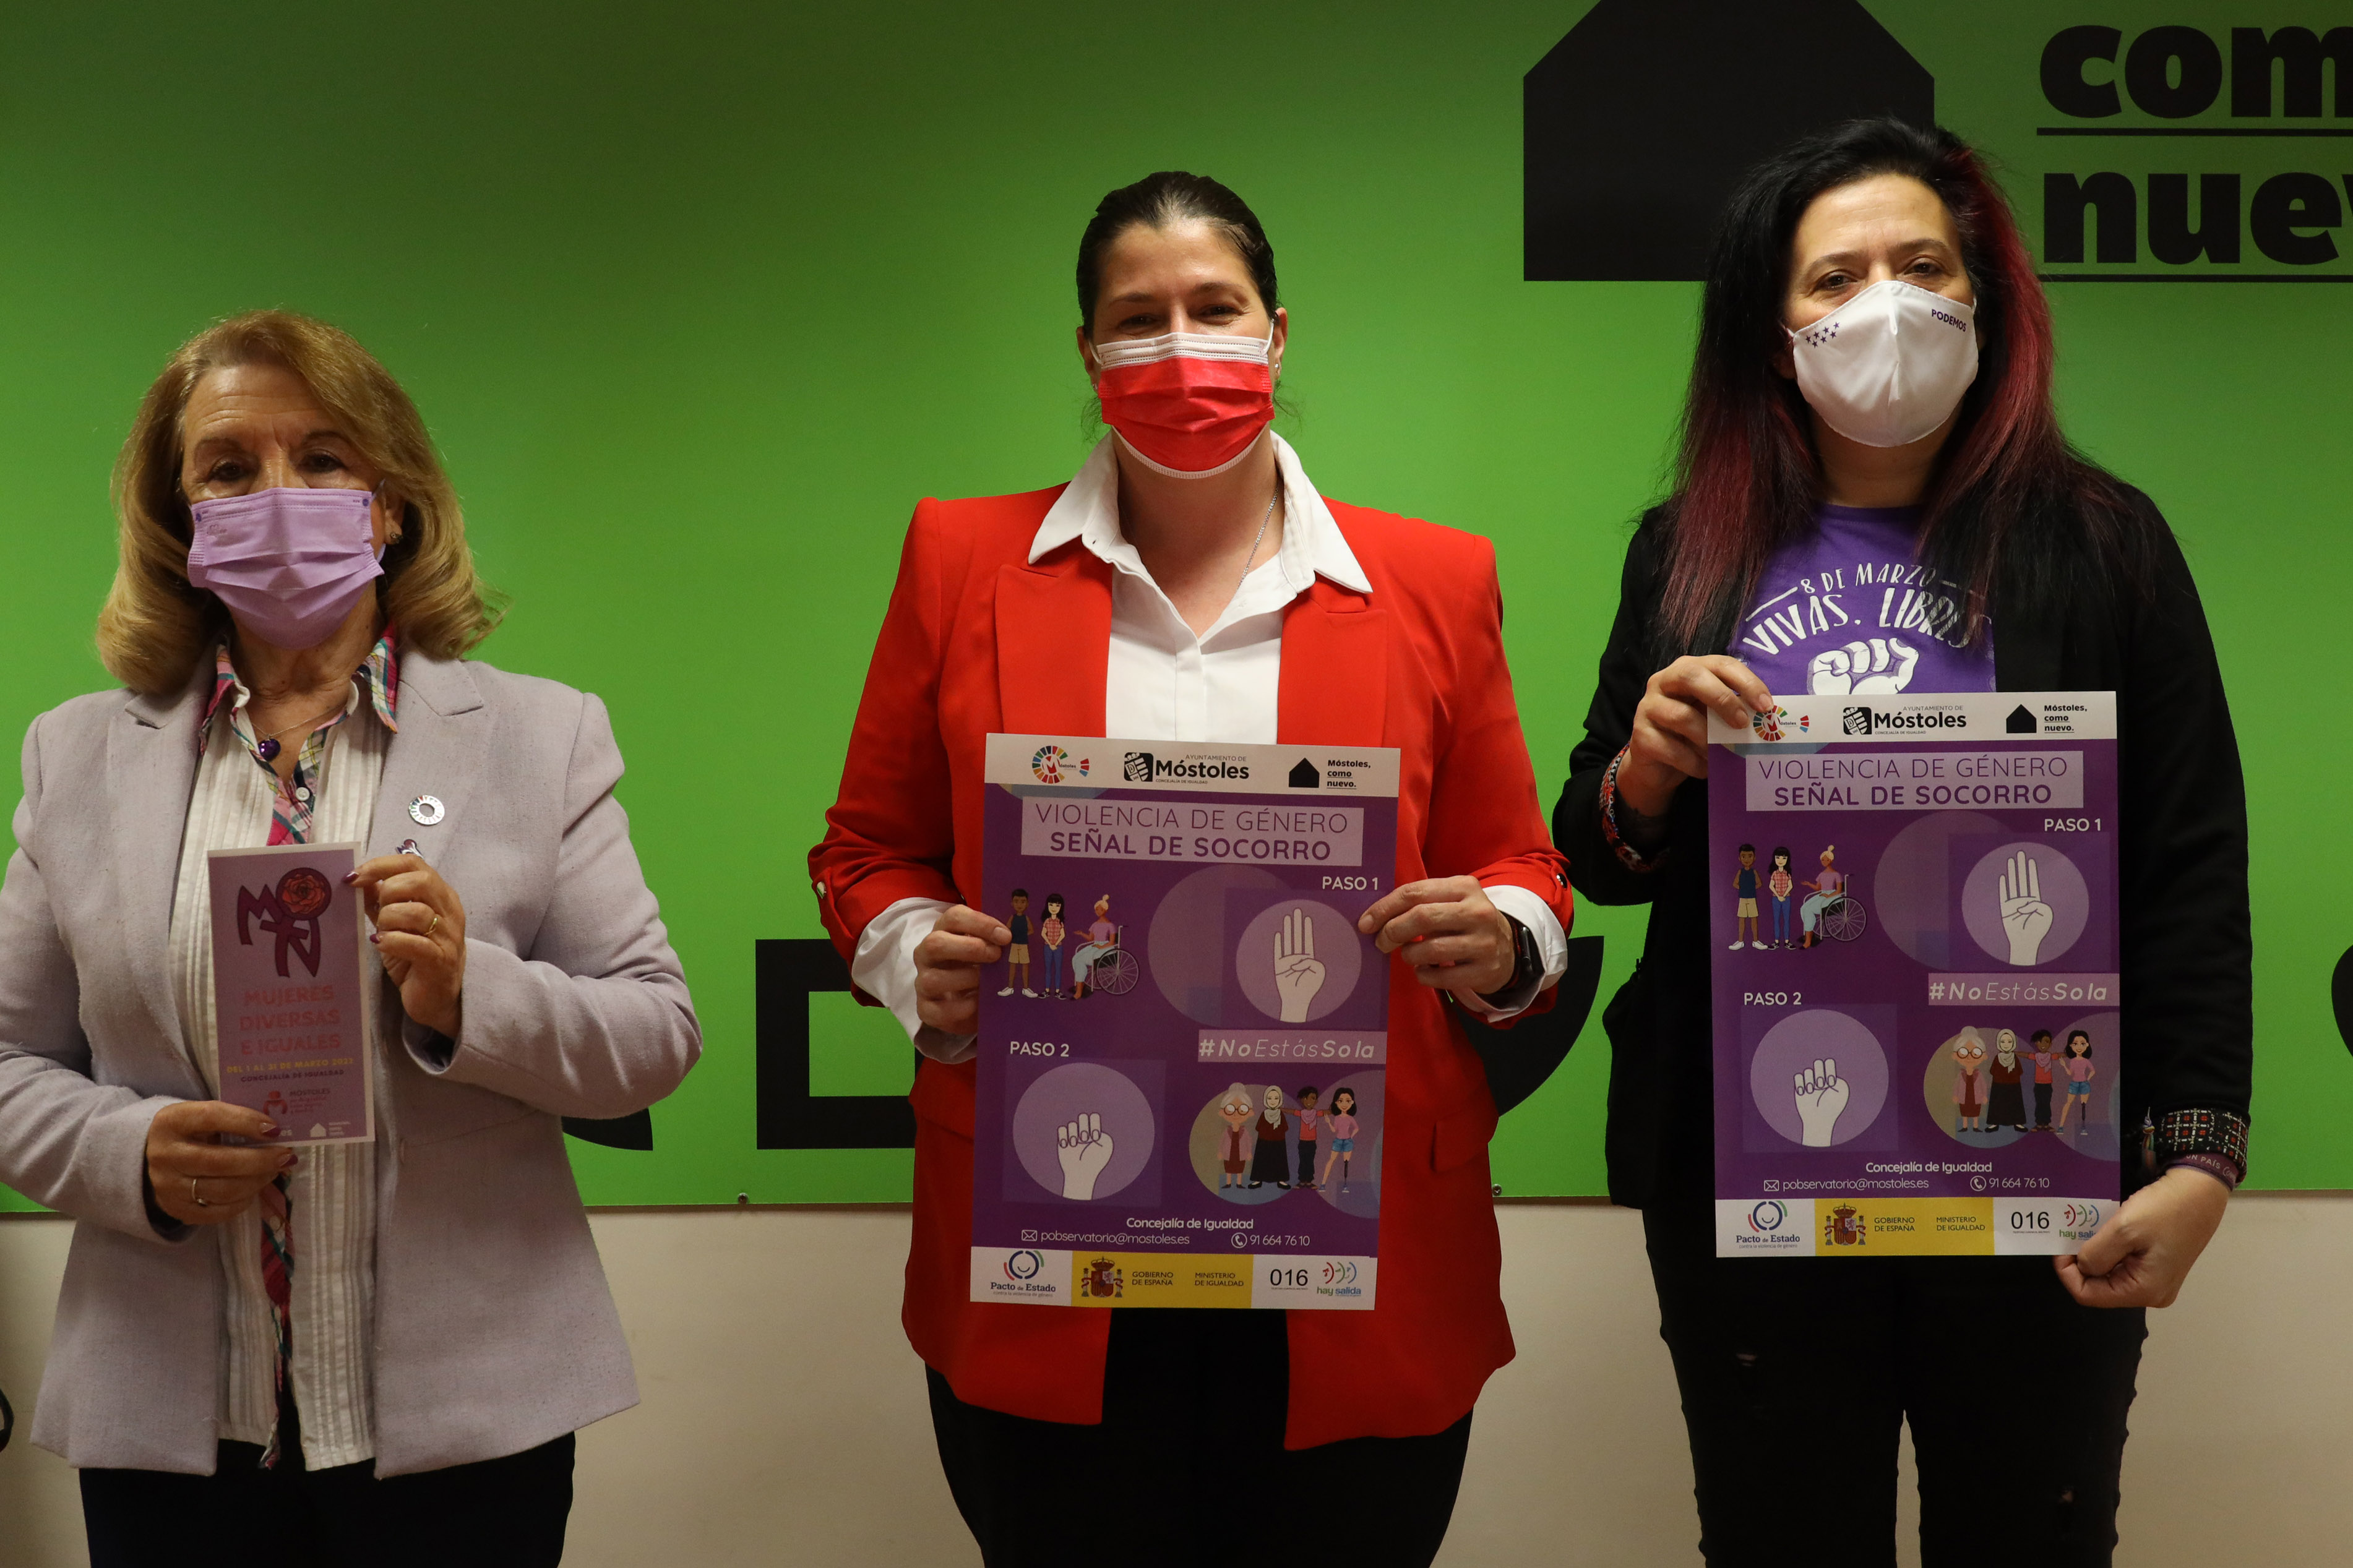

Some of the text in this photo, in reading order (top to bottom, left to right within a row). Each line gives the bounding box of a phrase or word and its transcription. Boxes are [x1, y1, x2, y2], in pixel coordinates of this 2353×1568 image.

[2044, 171, 2353, 265] nue
[1931, 309, 1967, 332] PODEMOS
[1801, 563, 1936, 593] 8 DE MARZO
[1743, 594, 1861, 655] VIVAS.
[2044, 705, 2088, 713] Móstoles,
[1875, 711, 1967, 728] Móstoles
[2044, 724, 2075, 732] nuevo.
[1156, 760, 1249, 779] Móstoles
[1328, 760, 1371, 768] Móstoles,
[1758, 754, 2067, 779] VIOLENCIA DE GÉNERO
[1774, 783, 2051, 805] SEÑAL DE SOCORRO
[1036, 803, 1348, 833] VIOLENCIA DE GÉNERO
[2044, 818, 2101, 831] PASO 1
[1050, 828, 1330, 860] SEÑAL DE SOCORRO
[1322, 876, 1378, 891] PASO 1
[244, 985, 334, 1006] MUJERES
[1744, 992, 1802, 1005] PASO 2
[1929, 982, 2107, 1001] #NoEstásSola
[239, 1009, 340, 1032] DIVERSAS
[241, 1034, 340, 1055] E IGUALES
[1010, 1041, 1070, 1057] PASO 2
[1200, 1039, 1375, 1058] #NoEstásSola
[226, 1065, 243, 1074] DEL
[295, 1059, 329, 1068] MARZO
[332, 1058, 354, 1066] 2022
[240, 1073, 290, 1082] CONCEJALÍA
[304, 1069, 345, 1078] IGUALDAD
[1865, 1162, 1992, 1175] Concejalía de Igualdad
[2200, 1156, 2221, 1169] PAÍS
[1783, 1178, 1929, 1191] pobservatorio@mostoles.es
[1989, 1178, 2050, 1188] 91 664 76 10
[1127, 1217, 1254, 1231] Concejalía de Igualdad
[1887, 1223, 1916, 1232] ESPAÑA
[2011, 1211, 2050, 1230] 016
[1041, 1230, 1189, 1245] pobservatorio@mostoles.es
[1250, 1235, 1310, 1246] 91 664 76 10
[2059, 1229, 2076, 1240] hay
[1144, 1278, 1173, 1286] ESPAÑA
[1270, 1269, 1308, 1286] 016
[991, 1282, 1015, 1290] Pacto
[1025, 1283, 1056, 1292] Estado
[1317, 1287, 1333, 1296] hay
